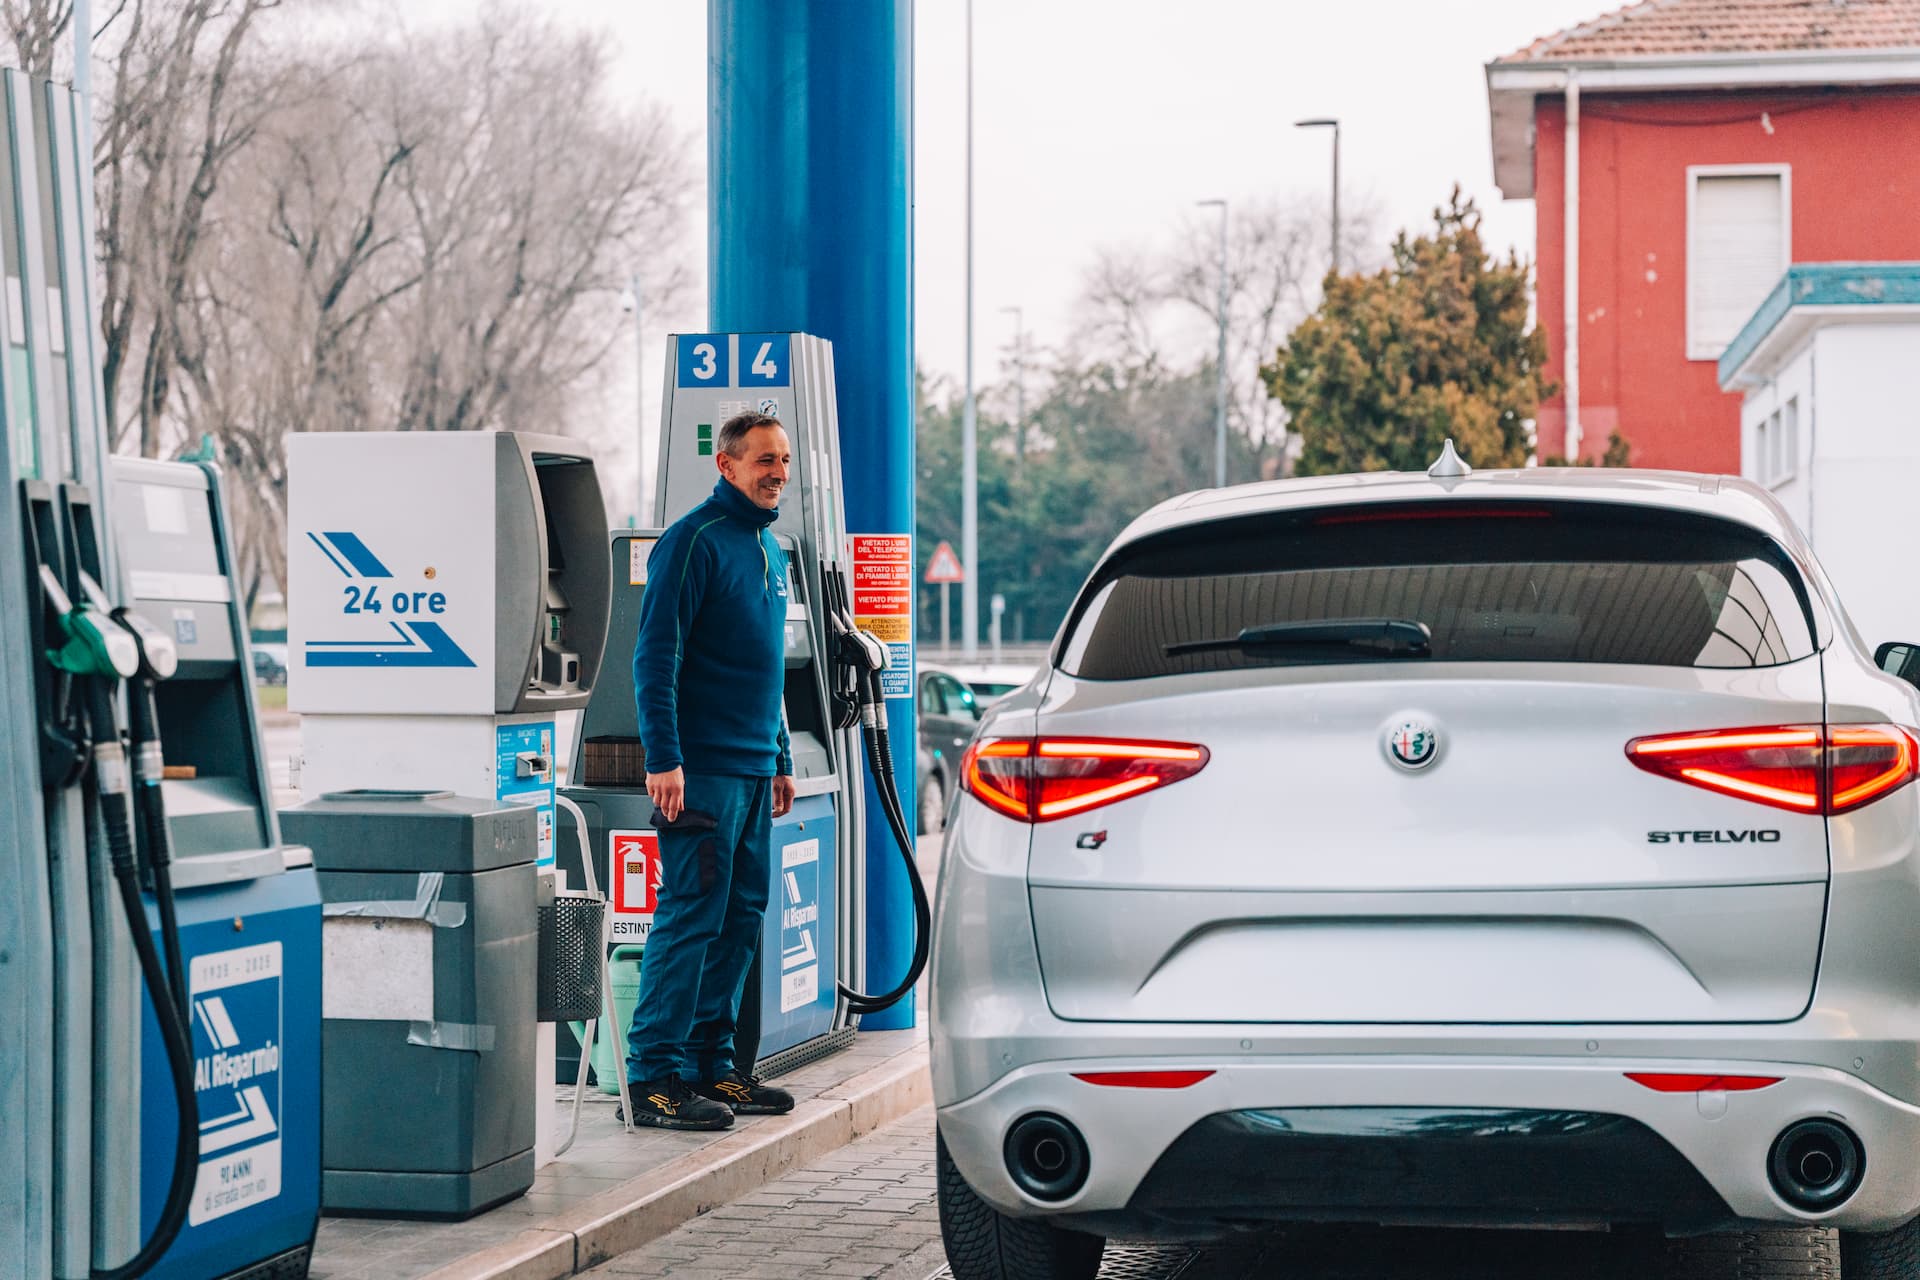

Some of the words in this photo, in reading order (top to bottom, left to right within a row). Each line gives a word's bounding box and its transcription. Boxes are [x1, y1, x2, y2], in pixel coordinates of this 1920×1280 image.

[692, 342, 717, 380] 3
[751, 342, 777, 379] 4
[344, 585, 382, 614] 24
[392, 592, 447, 614] ore
[1647, 829, 1781, 843] STELVIO
[212, 1040, 278, 1088] Risparmio
